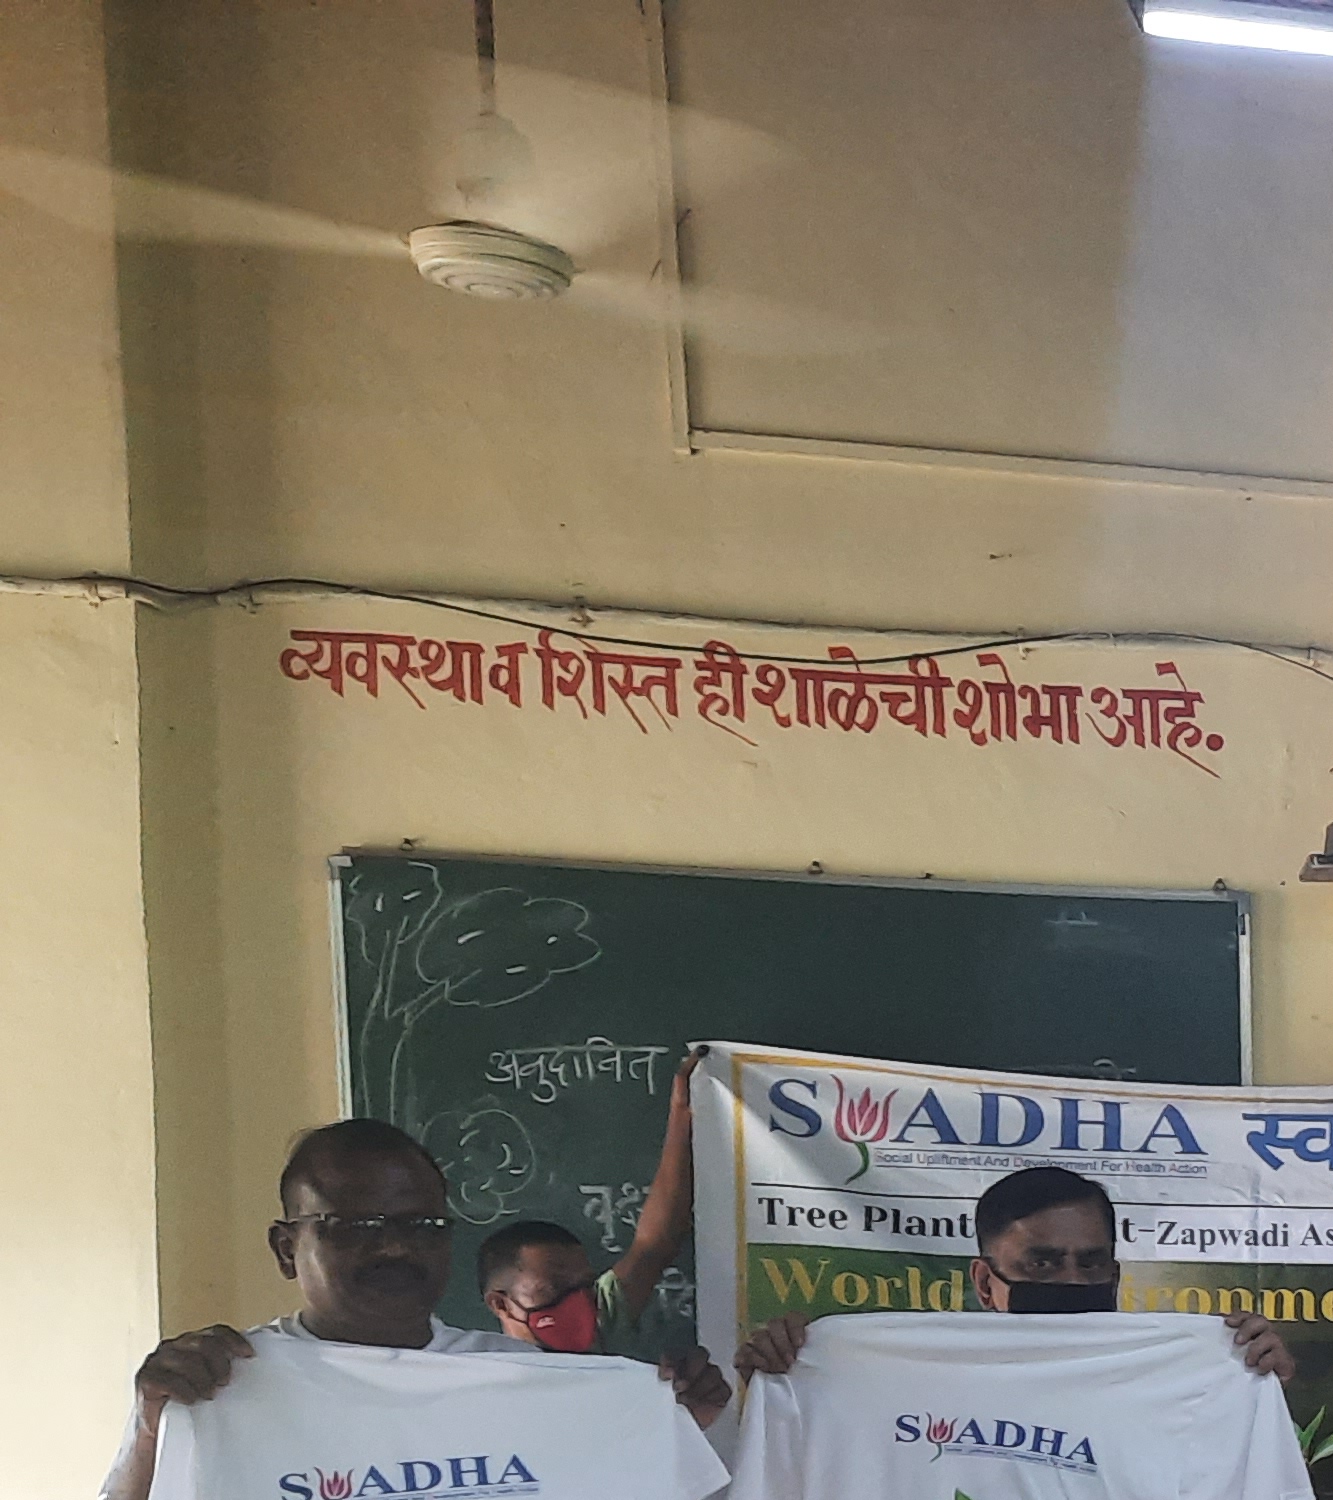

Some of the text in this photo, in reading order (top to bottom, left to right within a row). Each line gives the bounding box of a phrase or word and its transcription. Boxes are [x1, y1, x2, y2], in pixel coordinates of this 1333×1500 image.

[874, 1150, 913, 1164] Social
[984, 1155, 1009, 1167] And
[1101, 1160, 1122, 1171] For
[1126, 1161, 1166, 1173] Health
[1169, 1162, 1208, 1174] Action
[758, 1197, 848, 1231] Tree
[862, 1204, 976, 1240] Plant
[1116, 1217, 1290, 1254] t-Zapwadi
[759, 1257, 964, 1312] World
